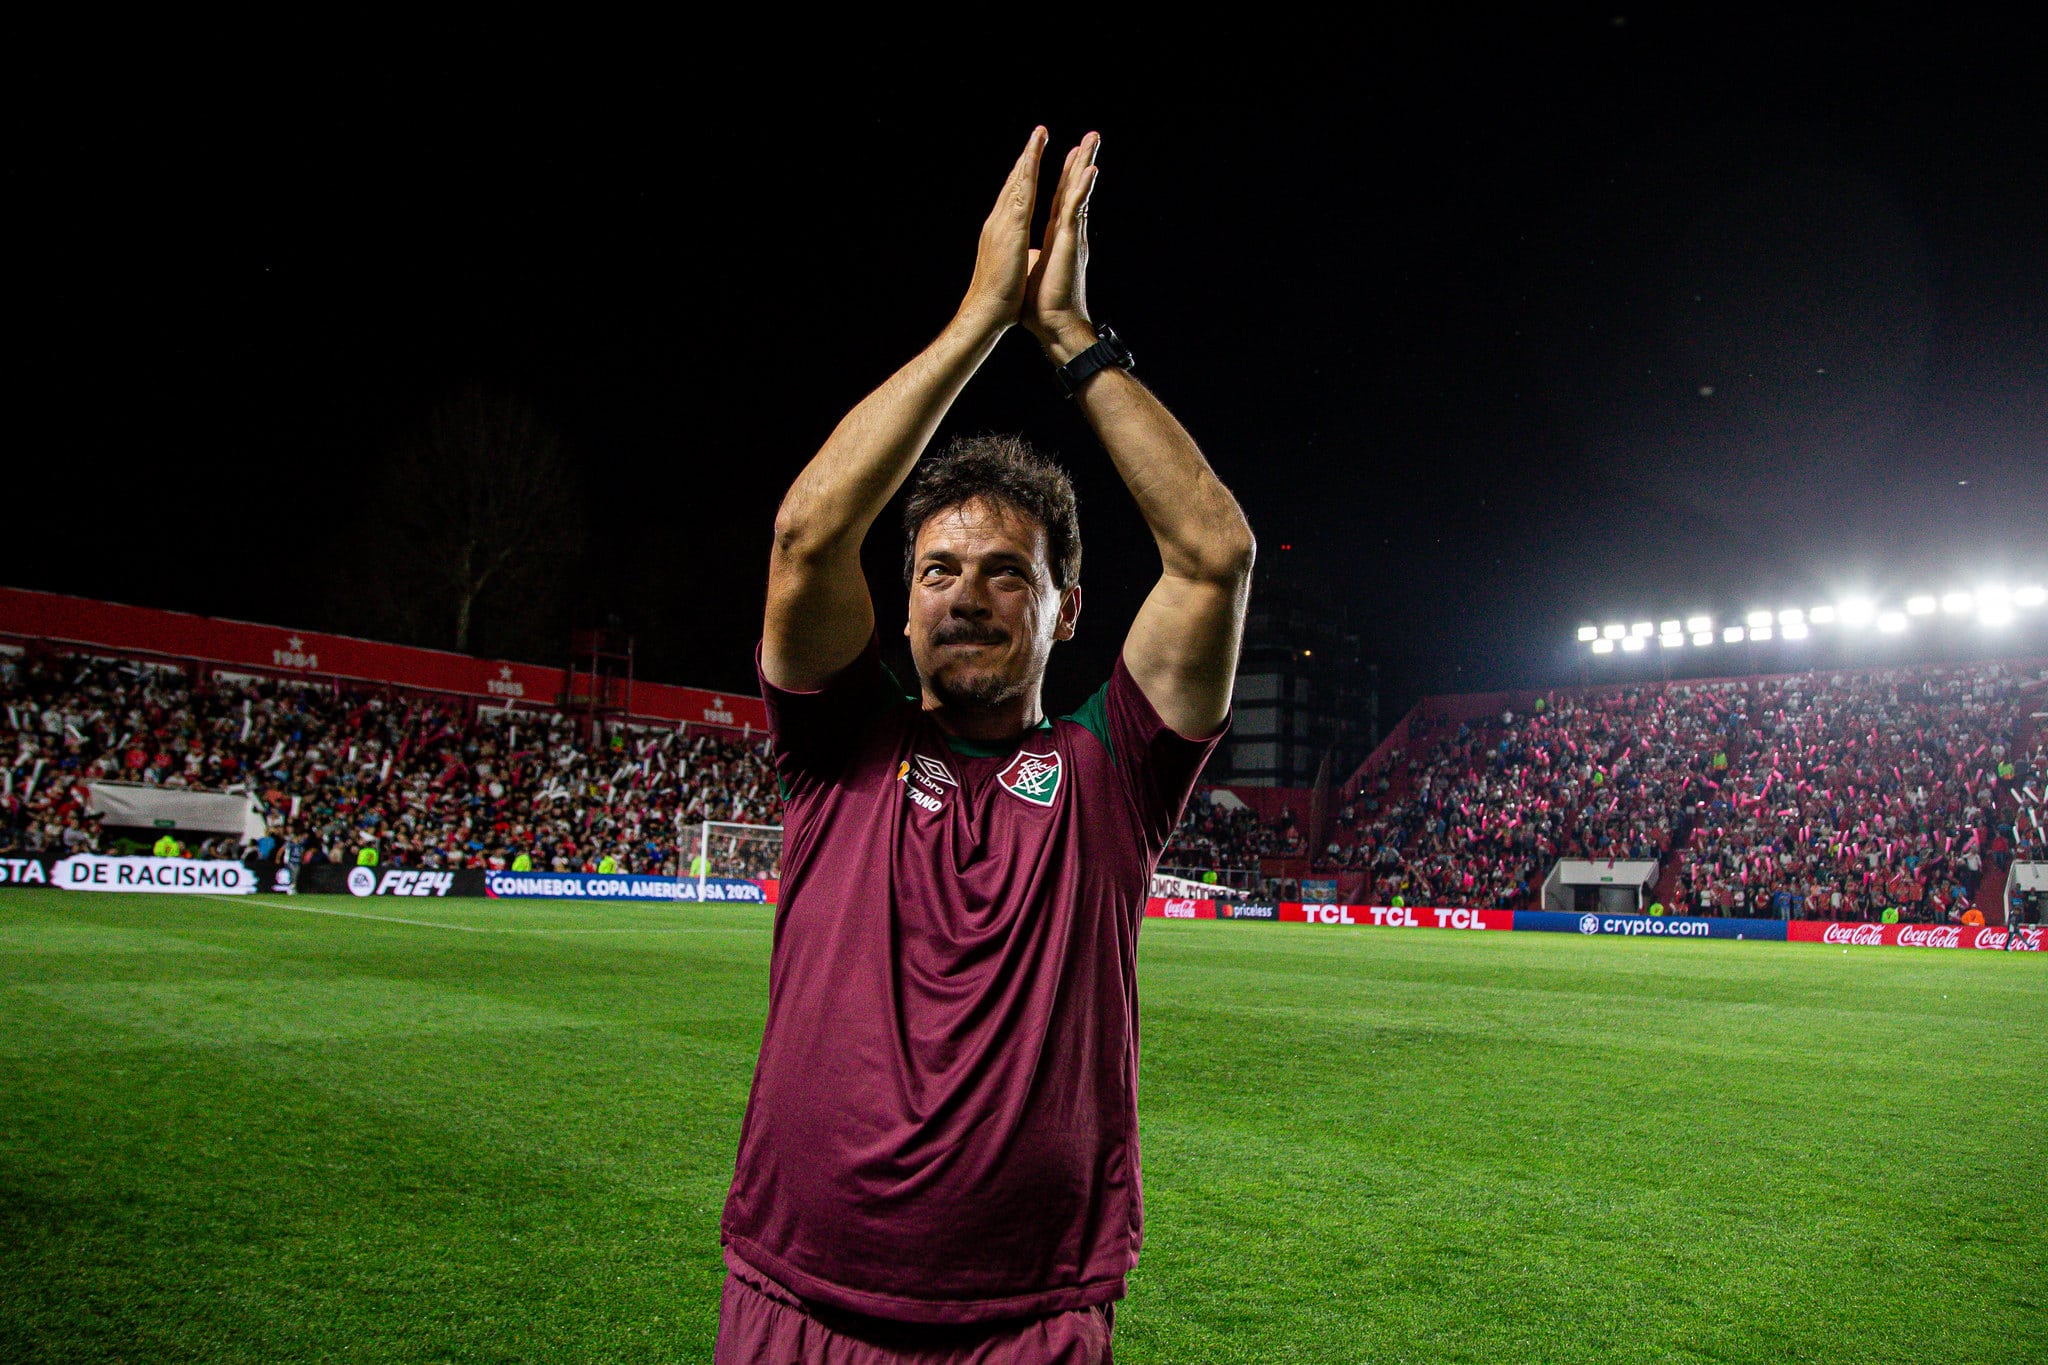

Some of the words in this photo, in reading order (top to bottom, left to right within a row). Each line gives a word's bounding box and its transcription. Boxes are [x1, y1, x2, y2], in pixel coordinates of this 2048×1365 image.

[910, 768, 945, 795] mbro
[905, 785, 943, 812] TANO
[72, 863, 108, 883] DE
[117, 864, 239, 887] RACISMO
[492, 877, 586, 896] CONMEBOL
[587, 879, 630, 896] COPA
[630, 881, 697, 899] AMERICA
[725, 884, 760, 900] 2024
[1234, 903, 1273, 918] priceless
[1302, 904, 1355, 924] TCL
[1370, 907, 1419, 927] TCL
[1434, 908, 1486, 930] TCL
[1603, 918, 1709, 936] crypto.com
[1823, 922, 1886, 946] Coca-Cola
[1896, 924, 1962, 948] Coca-Cola
